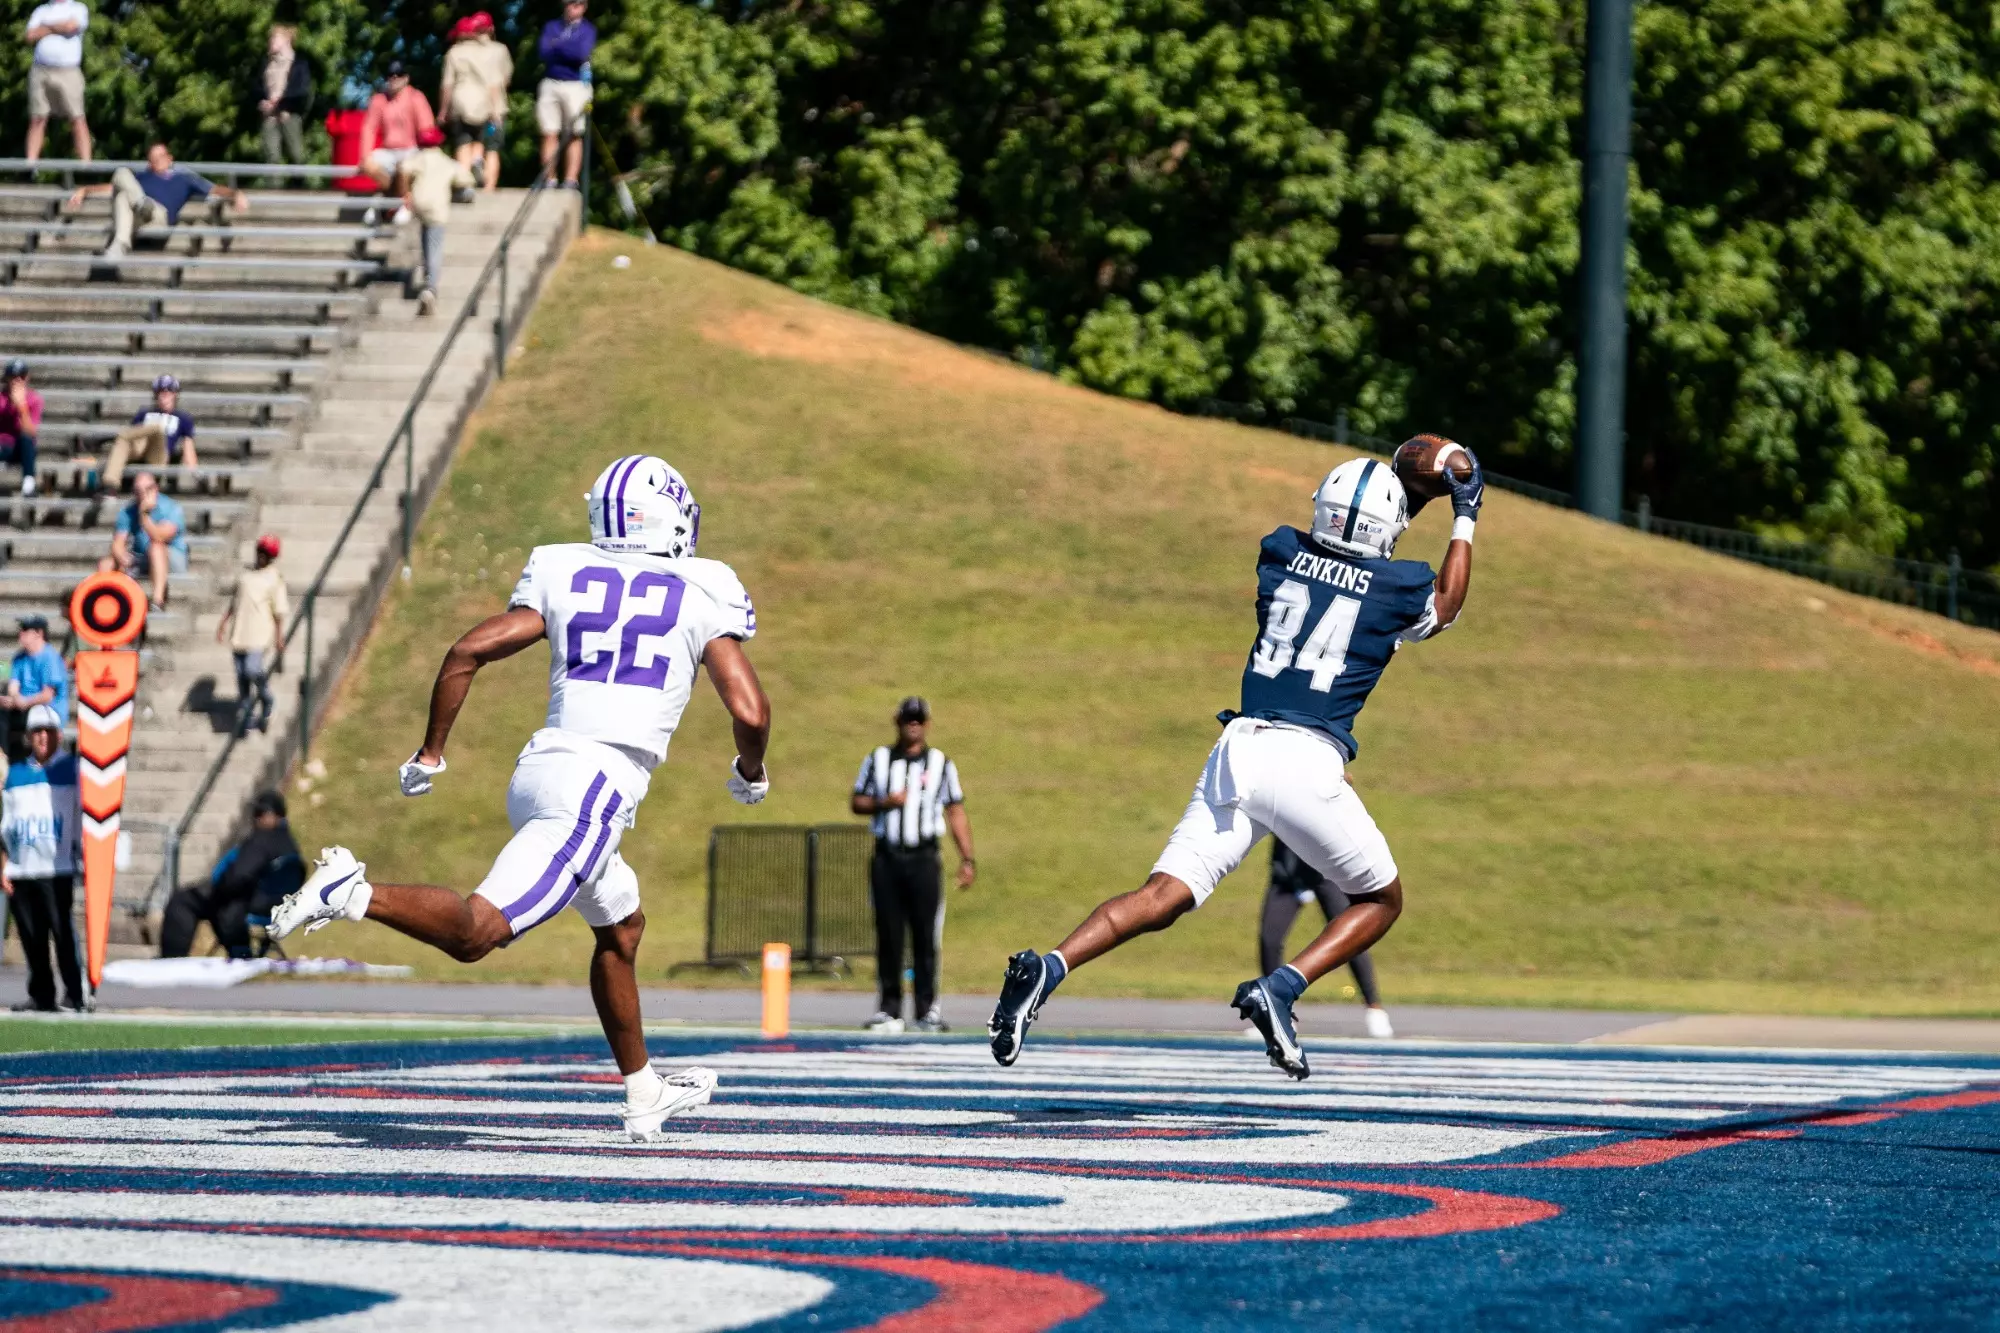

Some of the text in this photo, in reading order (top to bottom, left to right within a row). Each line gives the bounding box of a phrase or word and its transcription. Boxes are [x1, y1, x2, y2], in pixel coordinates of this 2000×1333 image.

[1357, 522, 1369, 532] 84
[1286, 551, 1374, 595] JENKINS
[566, 565, 687, 691] 22
[1252, 578, 1362, 694] 84
